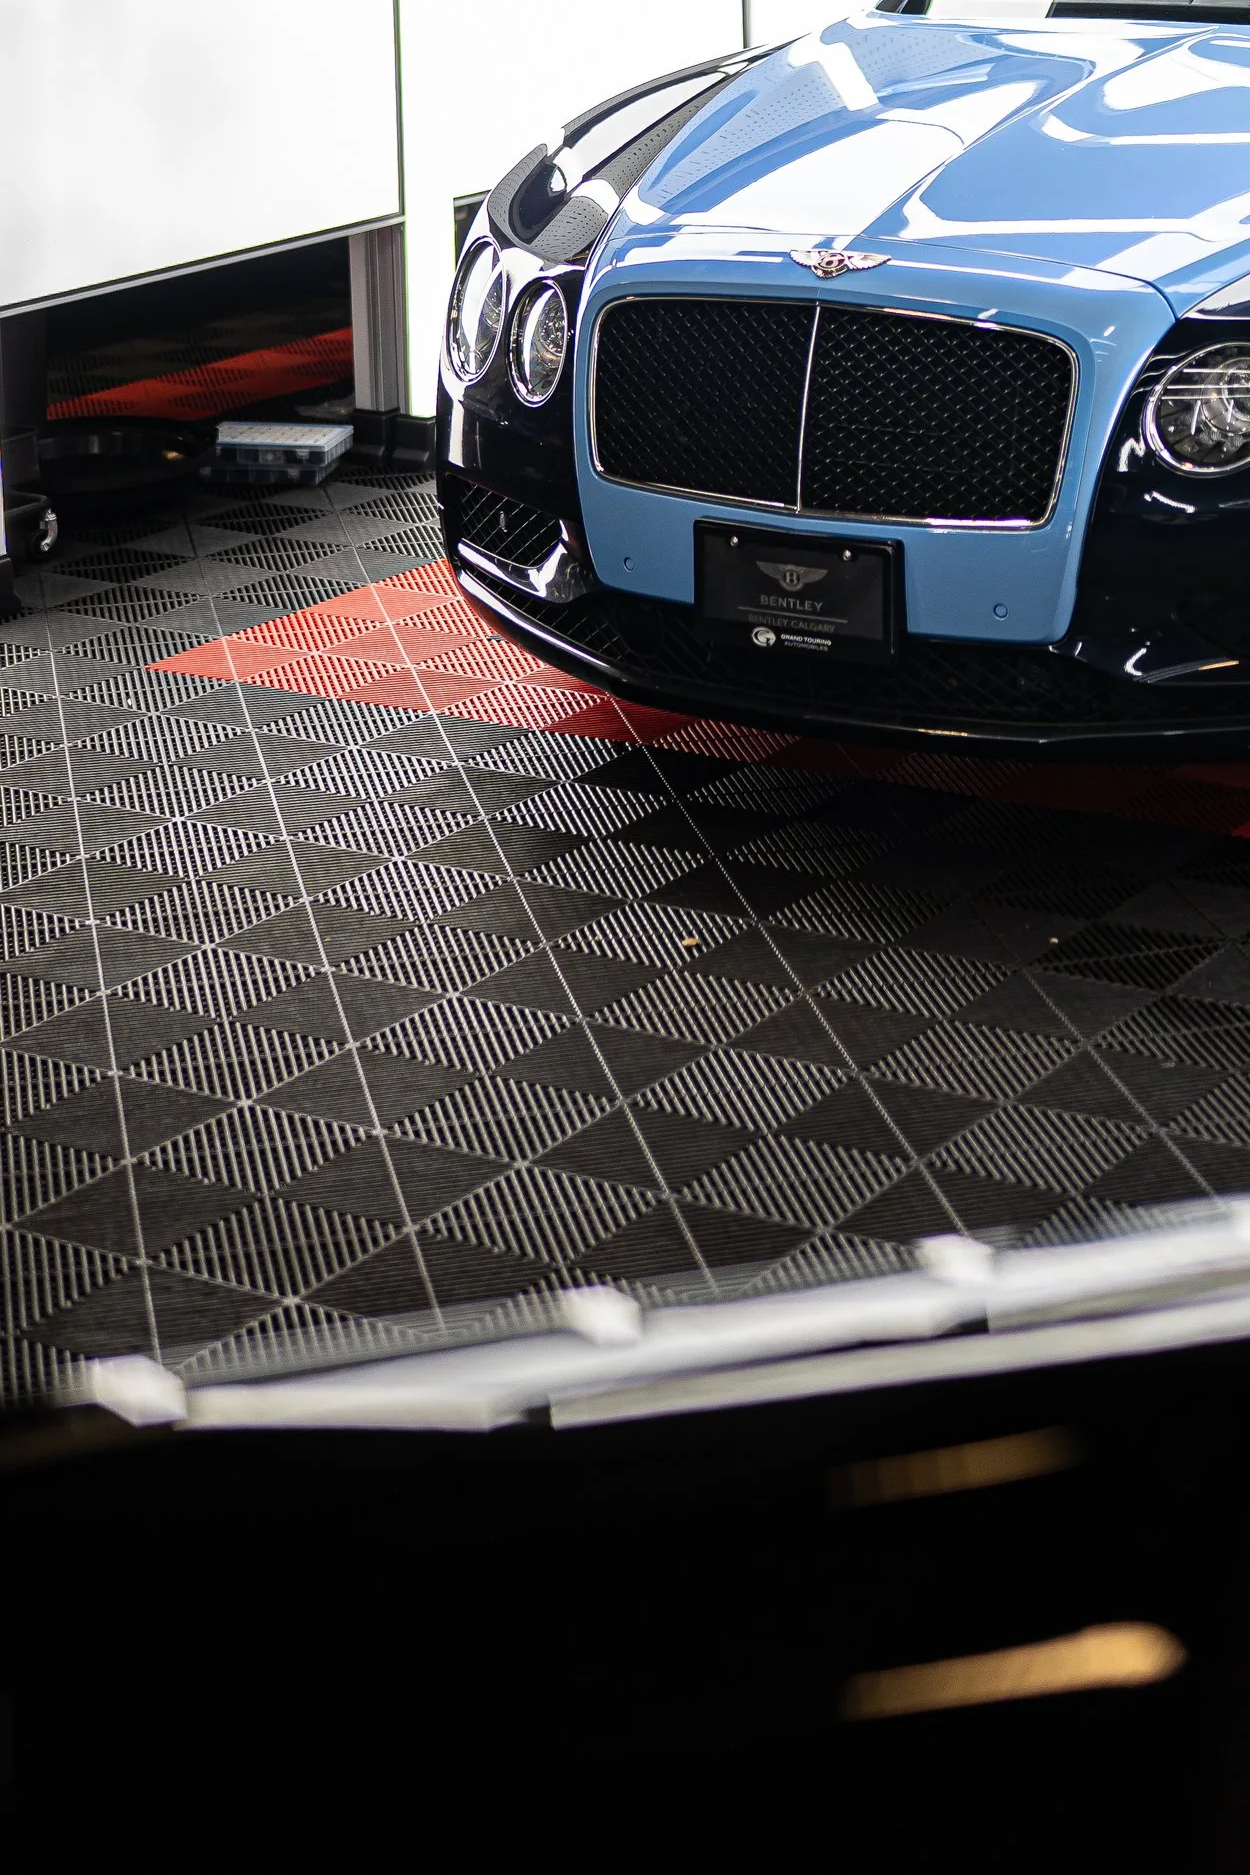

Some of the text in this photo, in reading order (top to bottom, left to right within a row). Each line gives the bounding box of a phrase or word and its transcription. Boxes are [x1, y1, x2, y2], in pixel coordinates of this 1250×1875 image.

[761, 595, 823, 612] BENTLEY
[748, 613, 836, 634] BENTLEY CALGARY
[780, 634, 831, 646] GRAND TOURING
[785, 641, 828, 651] AUTOMOBILES
